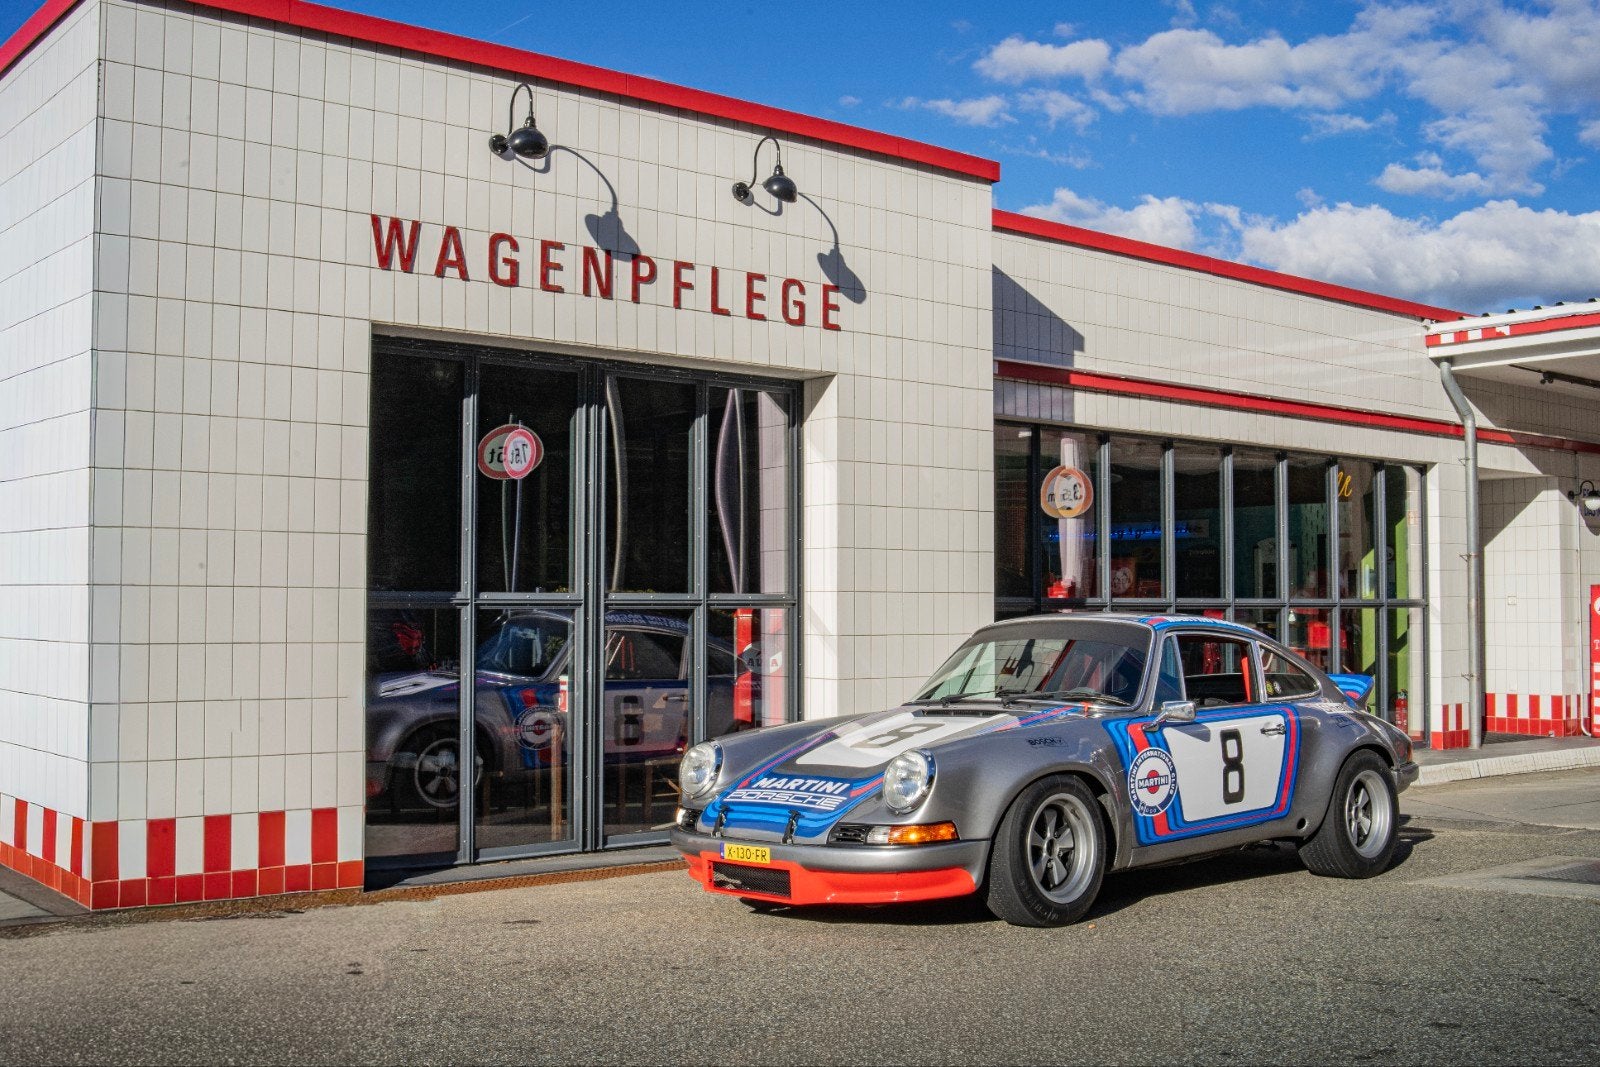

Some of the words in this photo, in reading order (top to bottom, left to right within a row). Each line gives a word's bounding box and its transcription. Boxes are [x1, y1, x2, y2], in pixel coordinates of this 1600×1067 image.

[370, 213, 841, 331] WAGENPFLEGE
[851, 722, 946, 749] 8
[1220, 728, 1245, 805] 8
[752, 778, 852, 795] MARTINI
[1130, 765, 1138, 802] MARTINI
[1139, 775, 1169, 788] MARTINI
[726, 790, 843, 808] PORSCHE
[727, 846, 767, 861] X-130-FR
